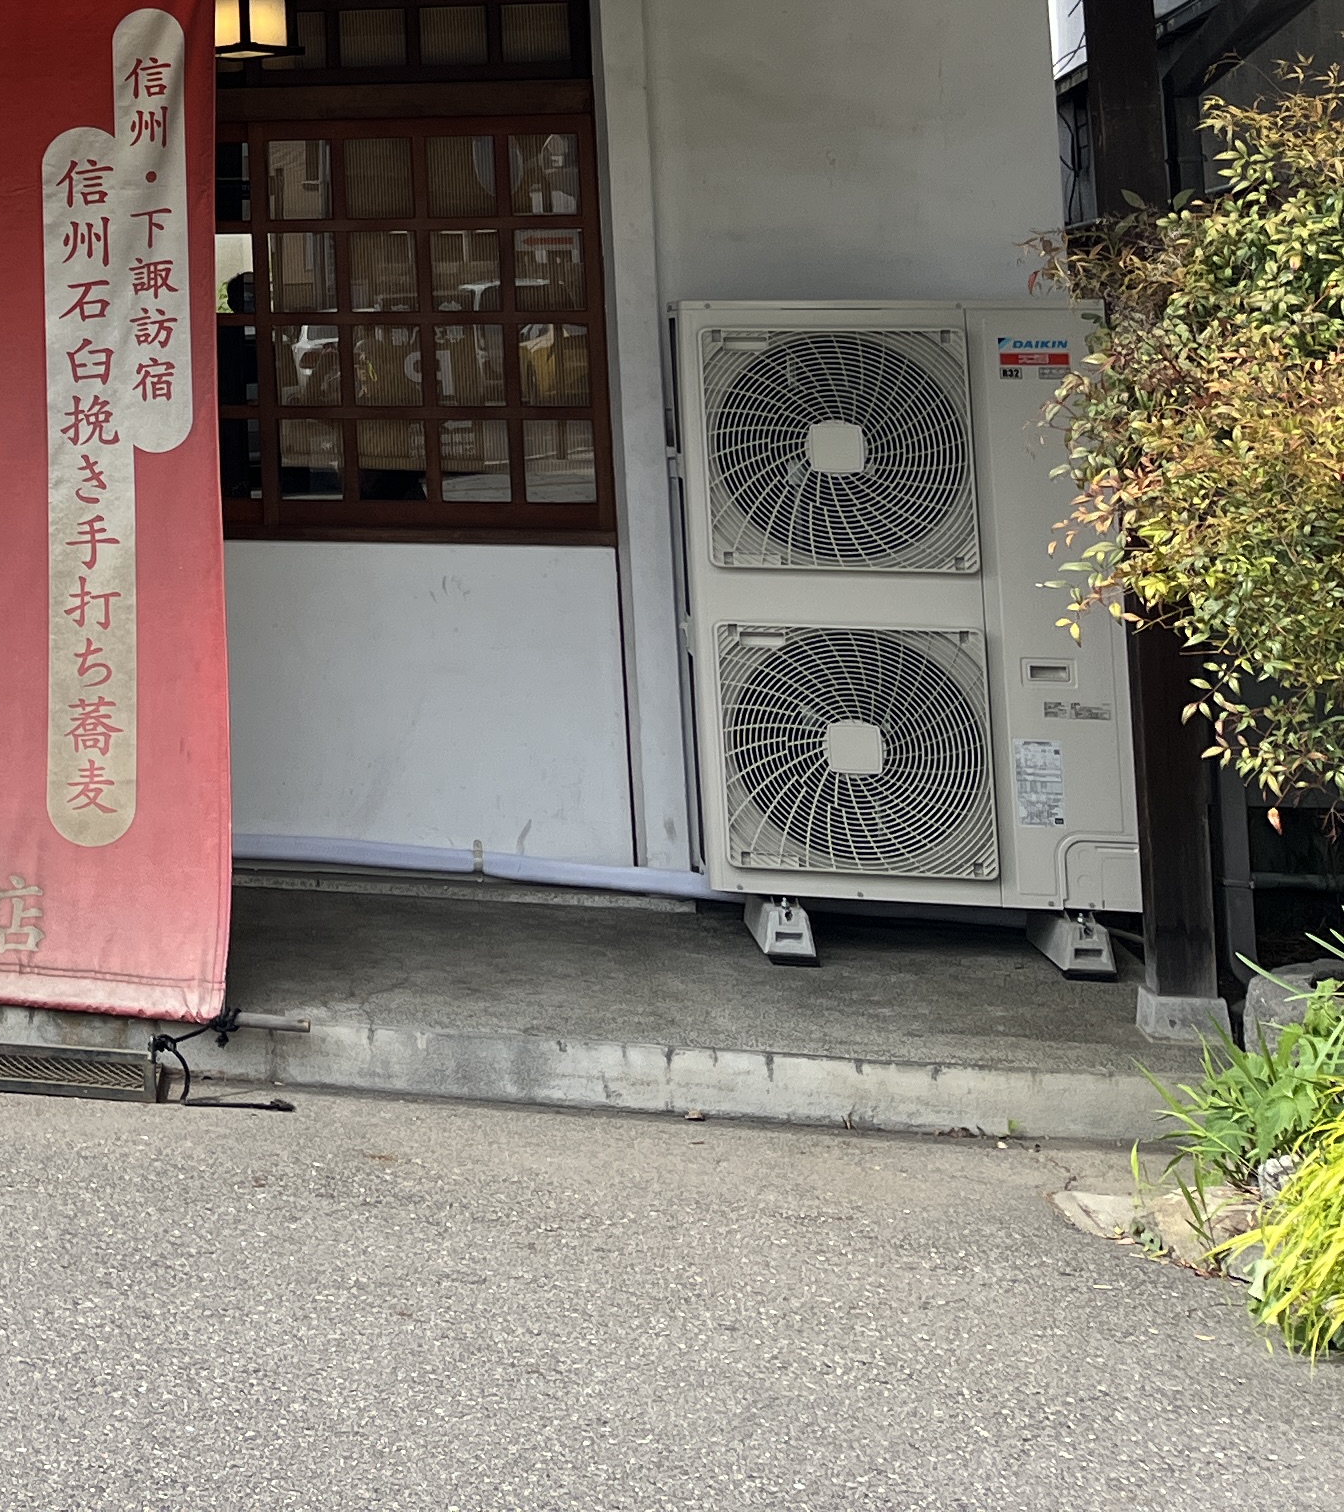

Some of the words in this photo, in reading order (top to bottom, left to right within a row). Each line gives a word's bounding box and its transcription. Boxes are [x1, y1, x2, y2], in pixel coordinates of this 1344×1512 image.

[125, 56, 179, 403] 信州・下諏訪宿
[1002, 369, 1020, 378] R32
[1012, 340, 1069, 349] DAIKIN
[55, 158, 124, 814] 信州石臼挽き手打ち蕎麦
